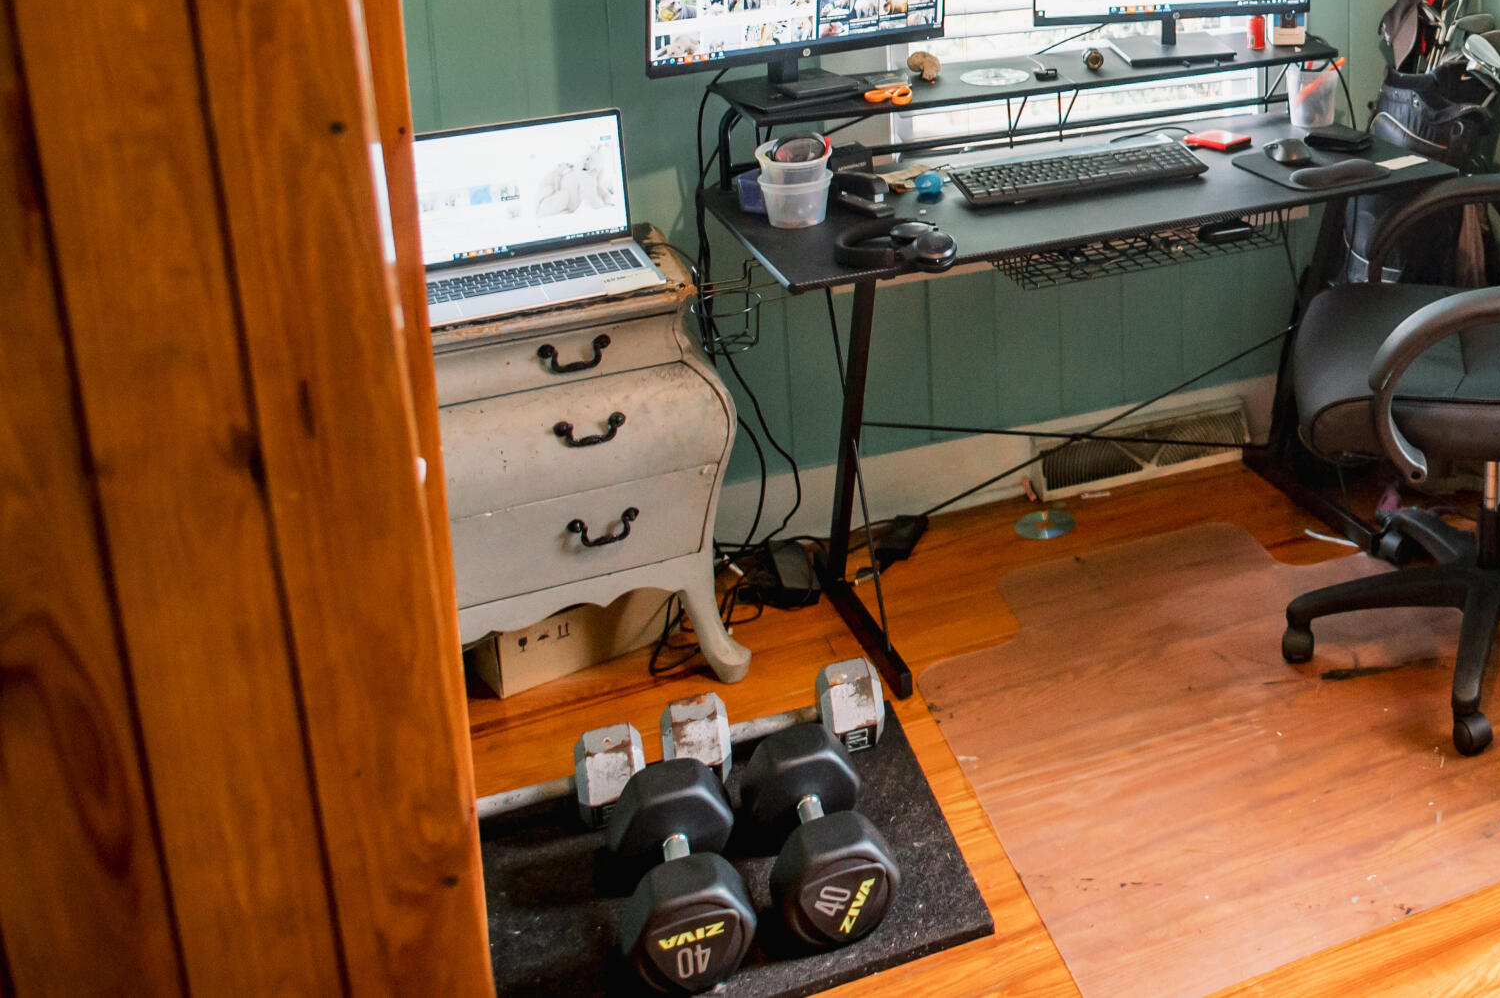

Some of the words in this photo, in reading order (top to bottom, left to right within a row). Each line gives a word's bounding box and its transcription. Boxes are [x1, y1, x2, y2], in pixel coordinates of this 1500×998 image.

[814, 886, 851, 917] 40
[839, 877, 876, 934] ZIVA
[658, 921, 725, 950] ZIVA
[677, 944, 711, 978] 40
